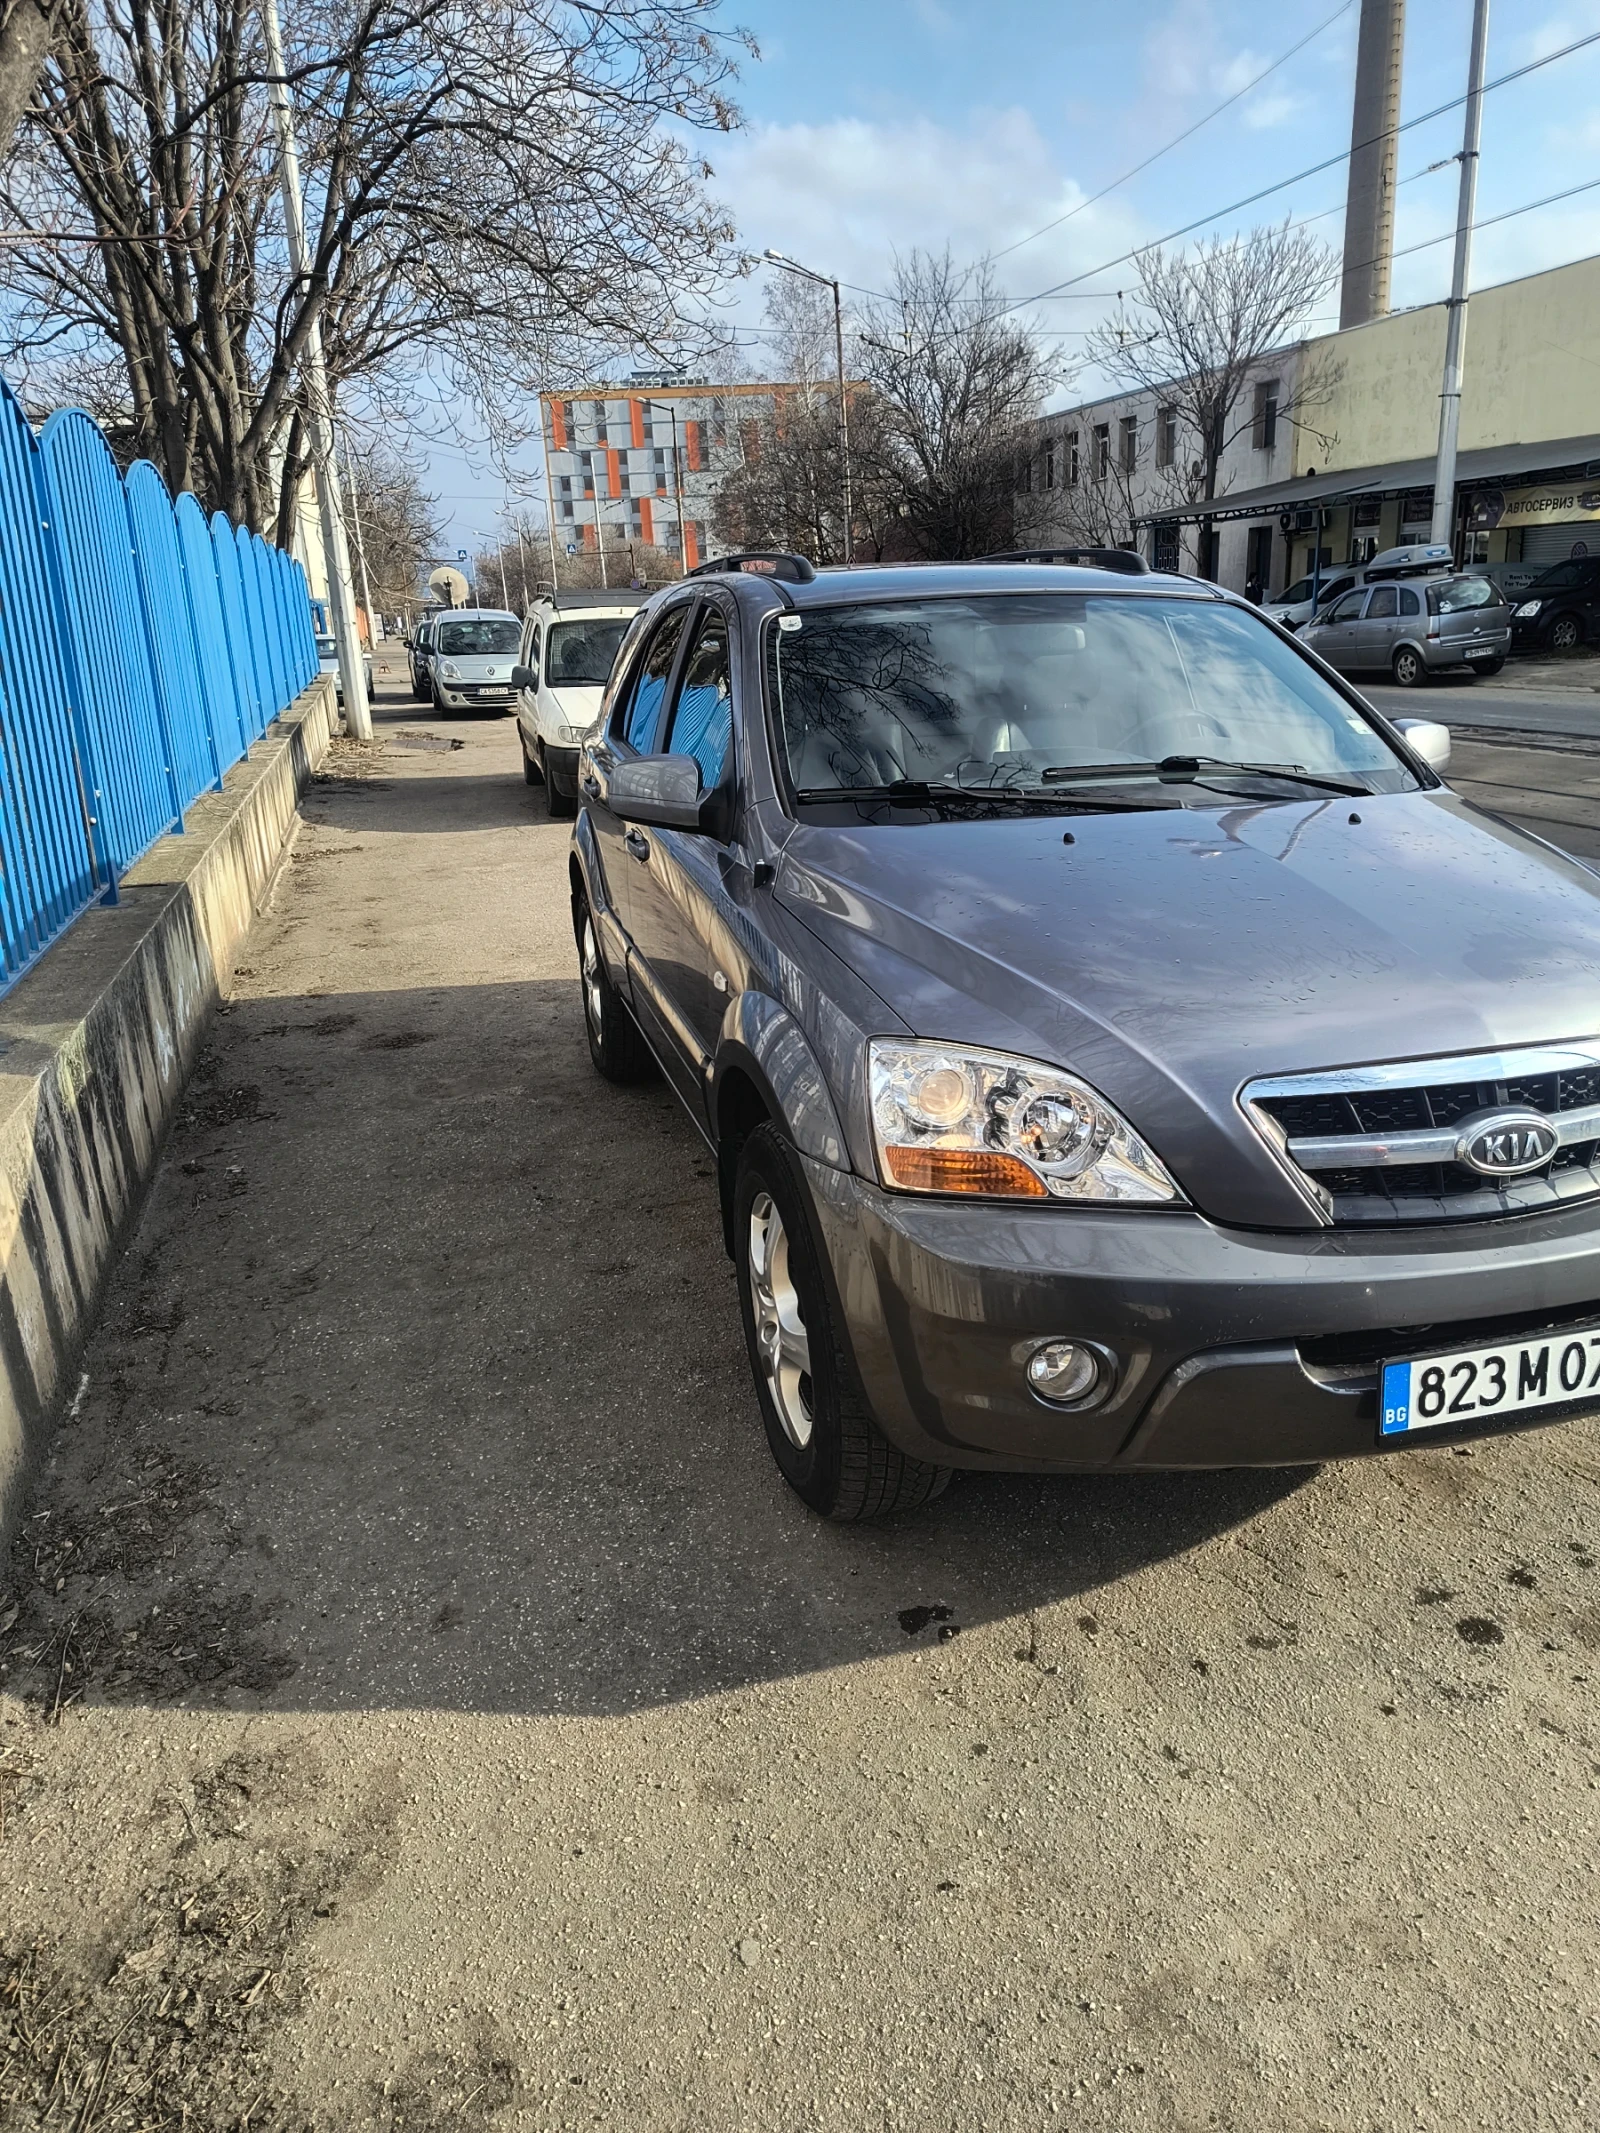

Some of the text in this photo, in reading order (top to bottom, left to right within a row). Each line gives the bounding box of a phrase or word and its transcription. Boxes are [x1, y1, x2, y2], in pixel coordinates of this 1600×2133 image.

[1506, 497, 1574, 514] АВТОСЕРВИЗ
[1483, 1130, 1544, 1163] KIA
[1417, 1355, 1507, 1418] 823
[1517, 1346, 1550, 1401] M
[1385, 1407, 1407, 1424] BG
